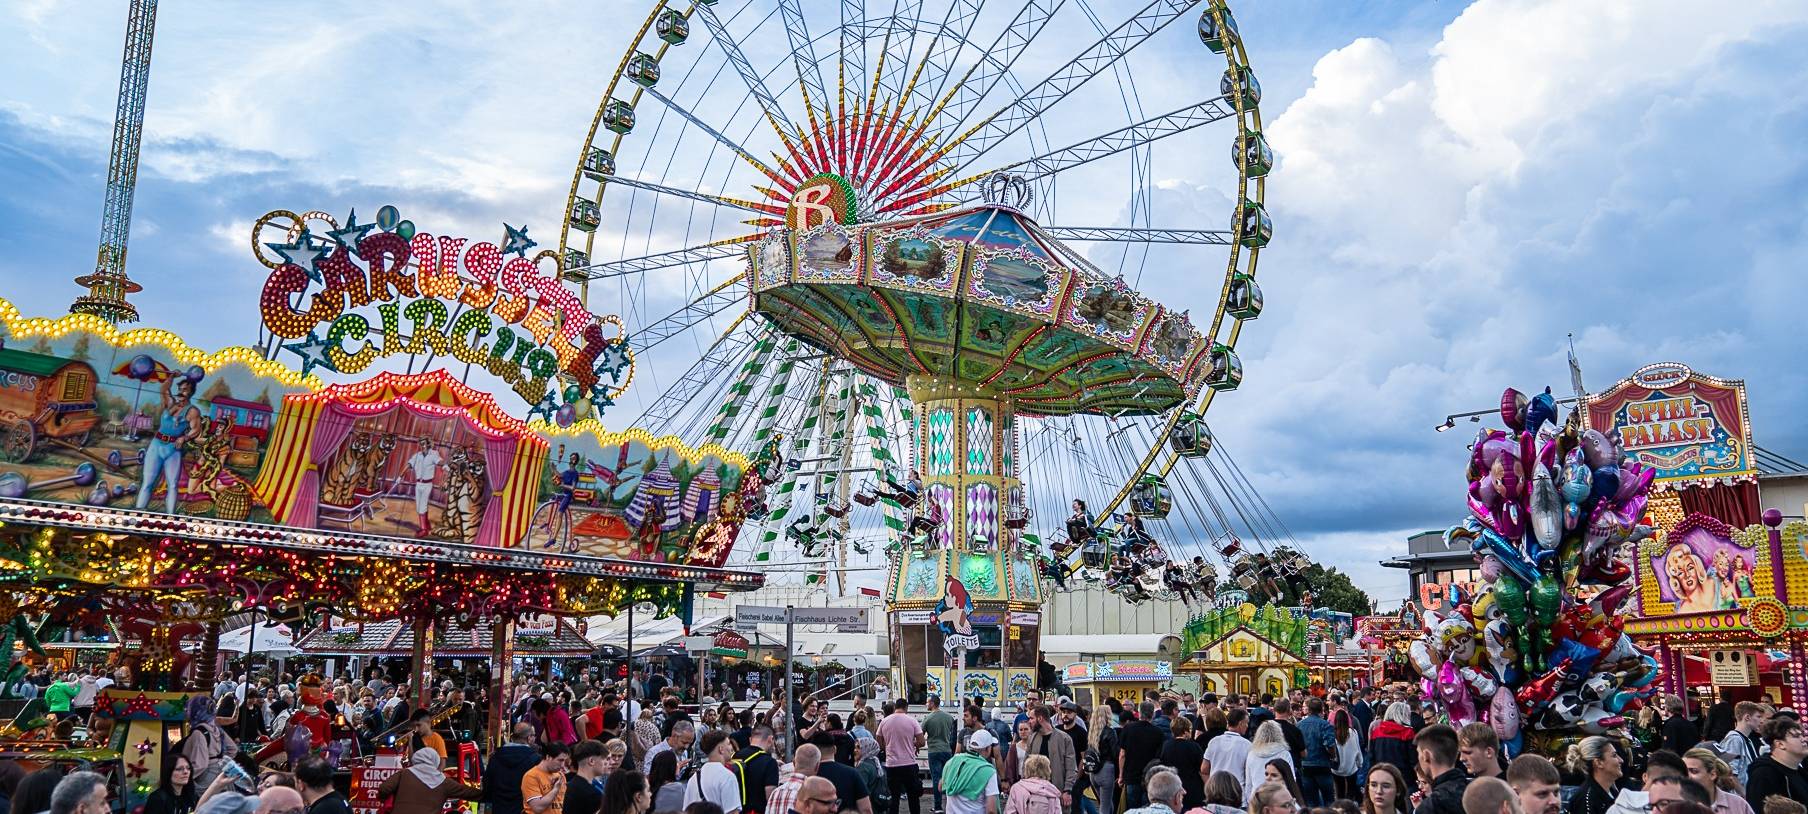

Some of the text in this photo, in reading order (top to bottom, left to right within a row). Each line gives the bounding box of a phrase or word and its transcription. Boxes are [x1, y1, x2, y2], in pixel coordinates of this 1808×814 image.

[327, 298, 558, 406] CIRCUS
[1628, 398, 1705, 424] SPIEL-
[1620, 419, 1712, 448] PALAST
[946, 636, 978, 648] TOILETTE
[1117, 689, 1136, 700] 312
[363, 769, 399, 781] CIRCU
